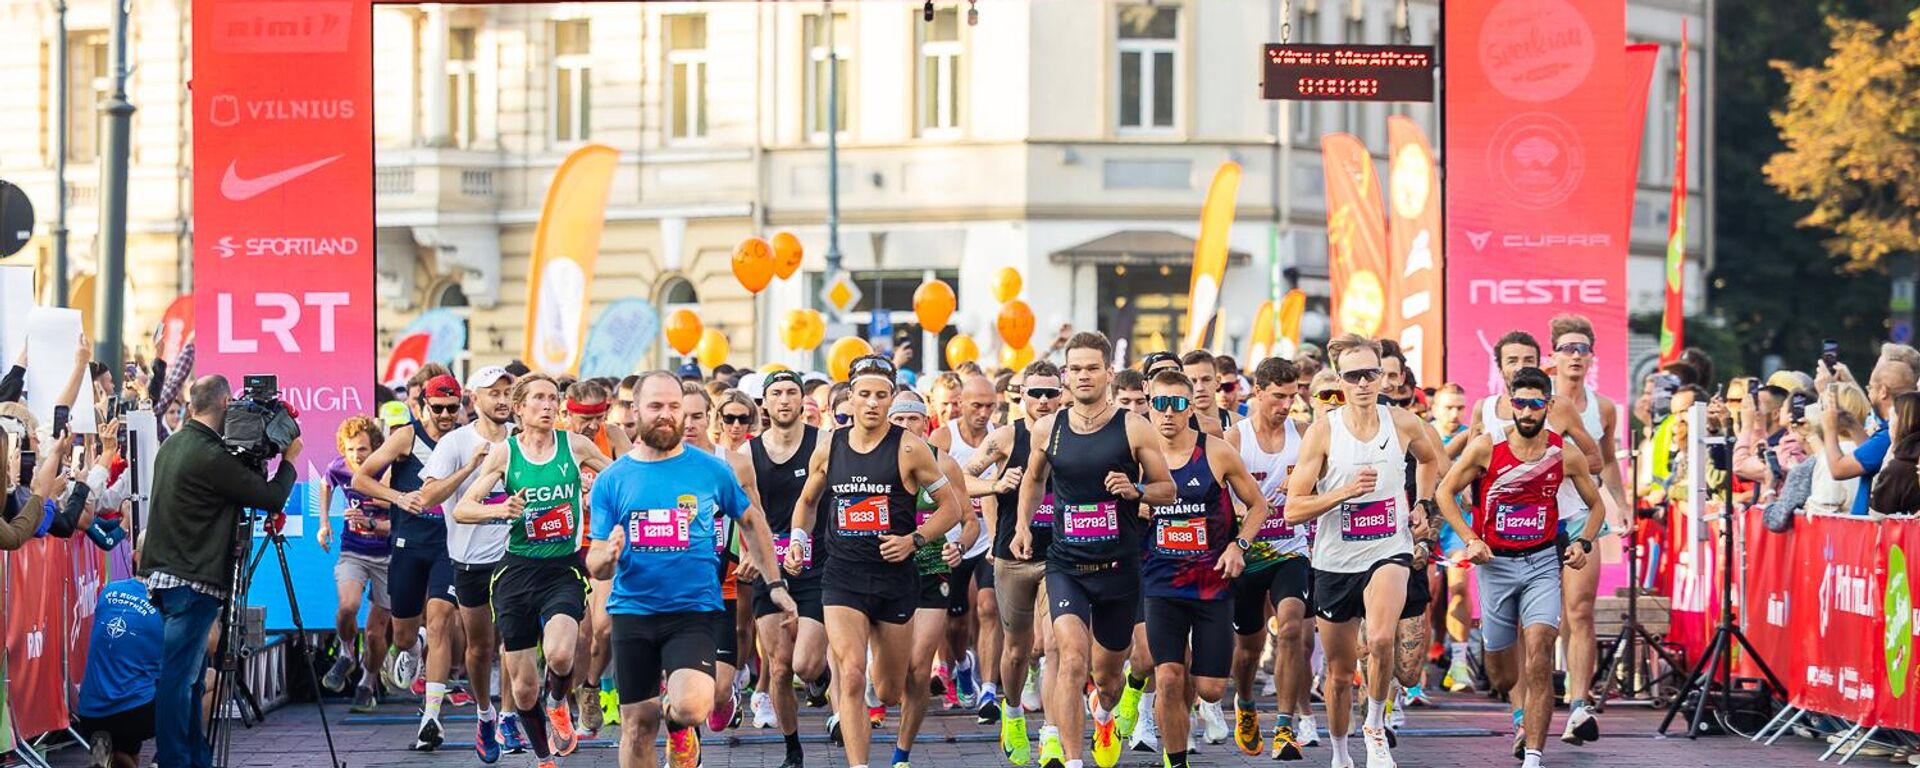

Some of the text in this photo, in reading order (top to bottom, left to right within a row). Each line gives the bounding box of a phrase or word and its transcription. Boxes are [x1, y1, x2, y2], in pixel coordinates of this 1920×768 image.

[247, 99, 356, 120] VILNIUS
[245, 237, 358, 257] SPORTLAND
[1503, 233, 1611, 248] CUPRA
[1469, 278, 1608, 305] NESTE
[217, 291, 350, 354] LRT
[851, 476, 869, 484] TOP
[849, 511, 875, 522] 1233
[1353, 514, 1385, 527] 12183
[1506, 517, 1538, 528] 12744
[540, 518, 562, 531] 435
[643, 524, 674, 537] 12113
[1167, 531, 1194, 543] 1838
[119, 592, 140, 602] RUN
